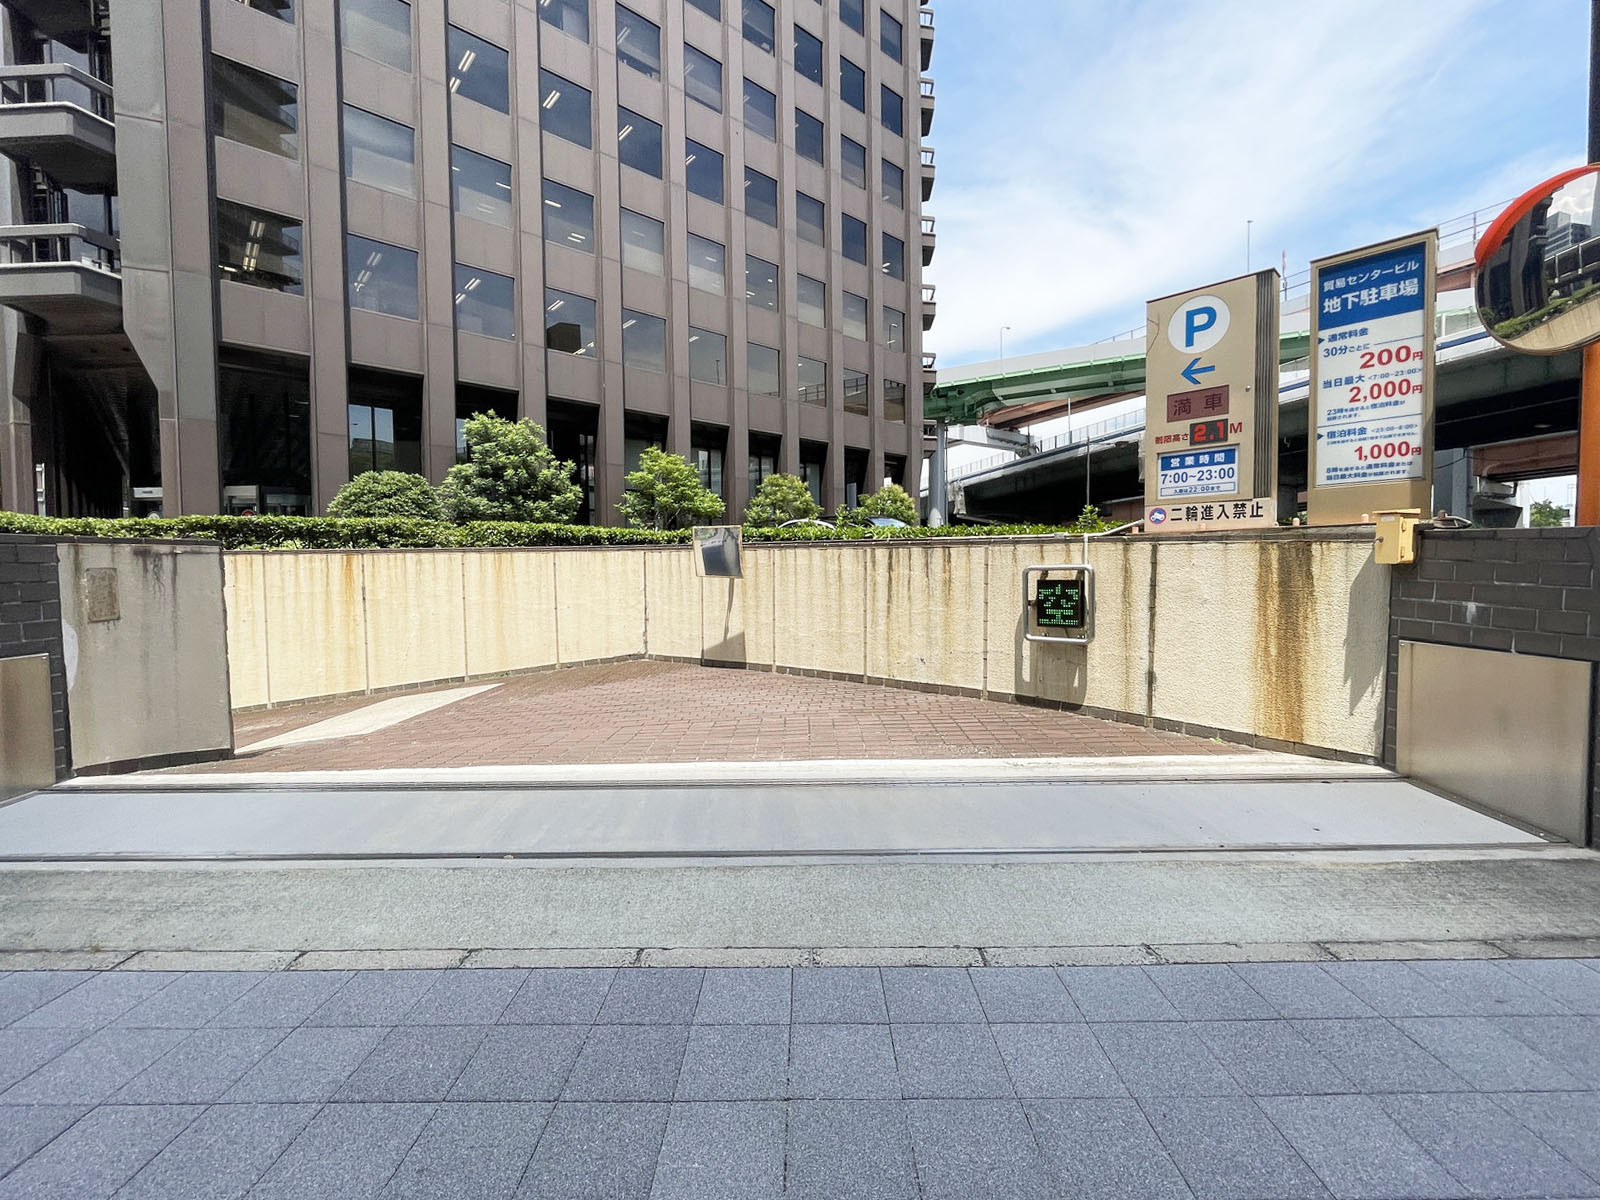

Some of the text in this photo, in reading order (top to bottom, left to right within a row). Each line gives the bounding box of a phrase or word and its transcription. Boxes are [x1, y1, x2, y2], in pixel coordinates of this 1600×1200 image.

[1322, 277, 1419, 313] 地下駐車場
[1185, 306, 1217, 347] P
[1327, 327, 1369, 343] 通常料金
[1359, 345, 1423, 369] 200円
[1322, 374, 1365, 389] 当日最大
[1348, 378, 1423, 403] 2,000円
[1173, 393, 1222, 416] 満車
[1193, 421, 1225, 442] 2.1
[1229, 421, 1243, 434] M
[1326, 425, 1368, 440] 宿泊料金
[1170, 452, 1226, 468] 営業時間
[1353, 440, 1422, 462] 1,000円
[1170, 501, 1264, 522] 二輪進入禁止
